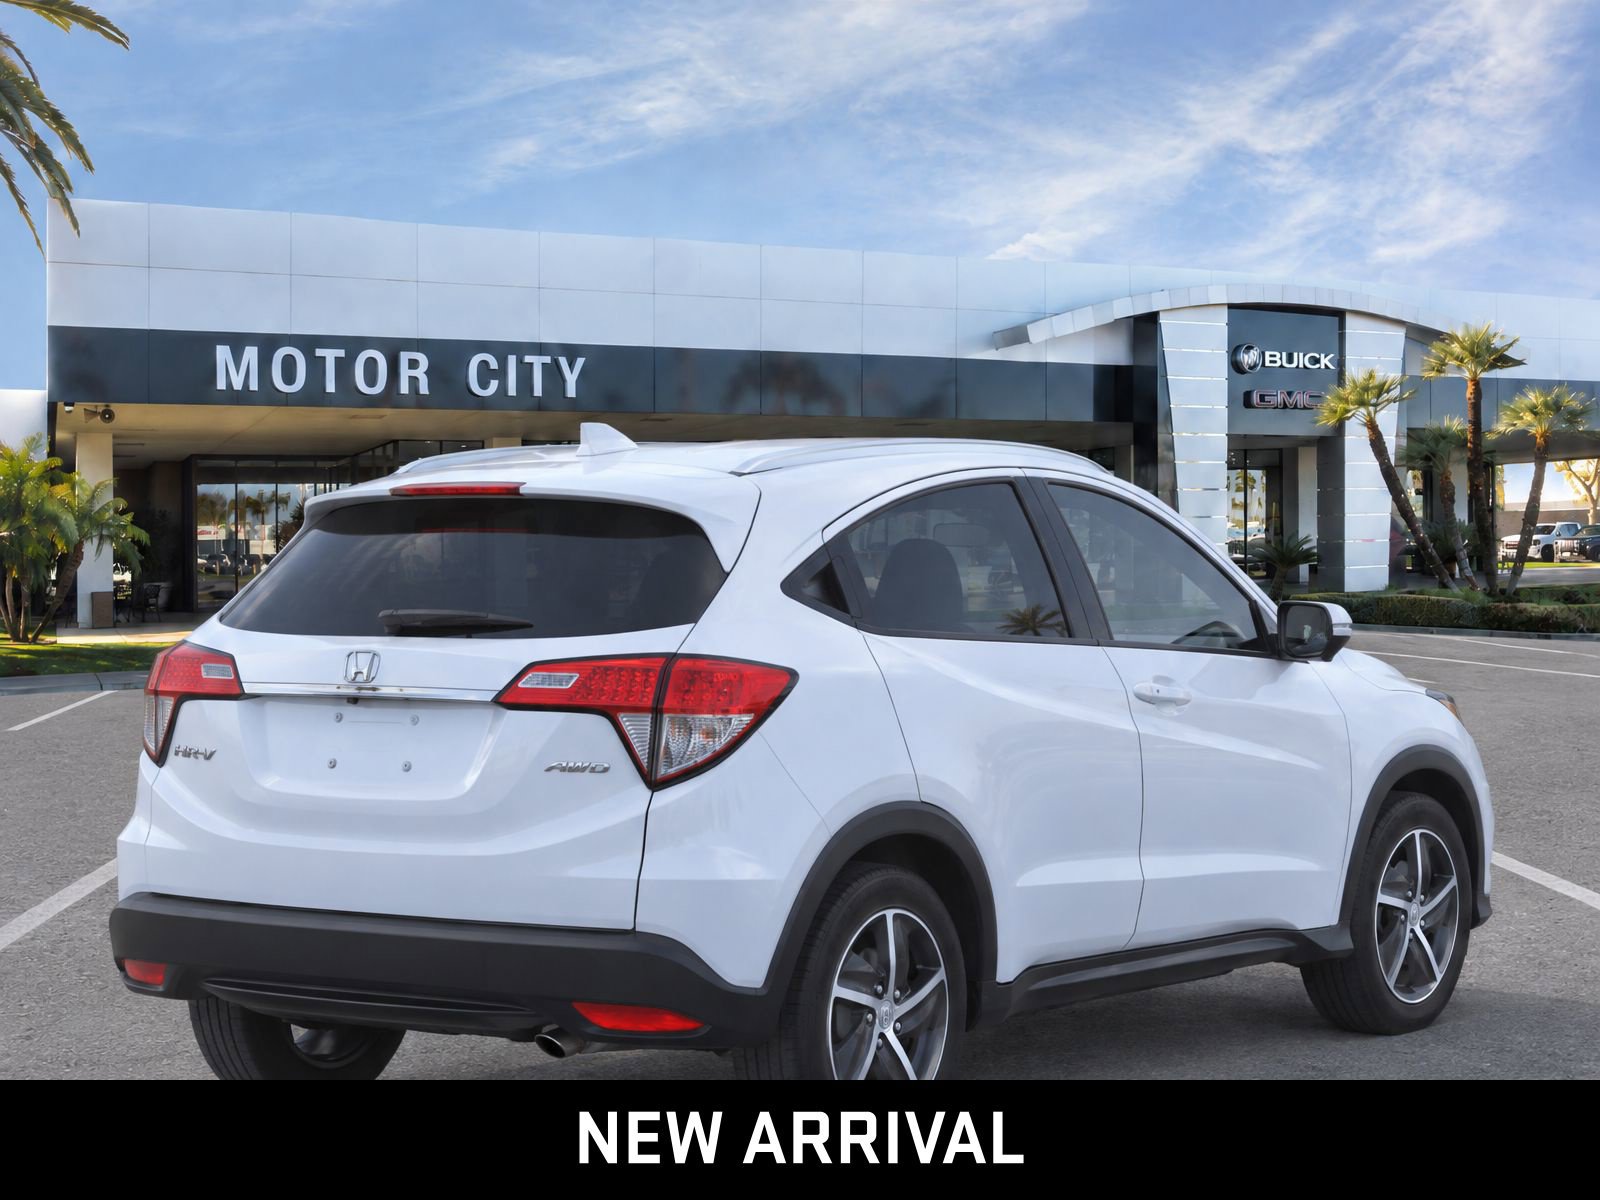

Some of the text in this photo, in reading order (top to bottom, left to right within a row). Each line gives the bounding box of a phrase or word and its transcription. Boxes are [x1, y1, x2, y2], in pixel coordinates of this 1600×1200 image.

[1264, 351, 1336, 370] BUICK
[215, 344, 586, 398] MOTOR CITY
[1253, 390, 1325, 409] GMC
[174, 744, 217, 761] HR-V
[543, 761, 611, 774] AWD
